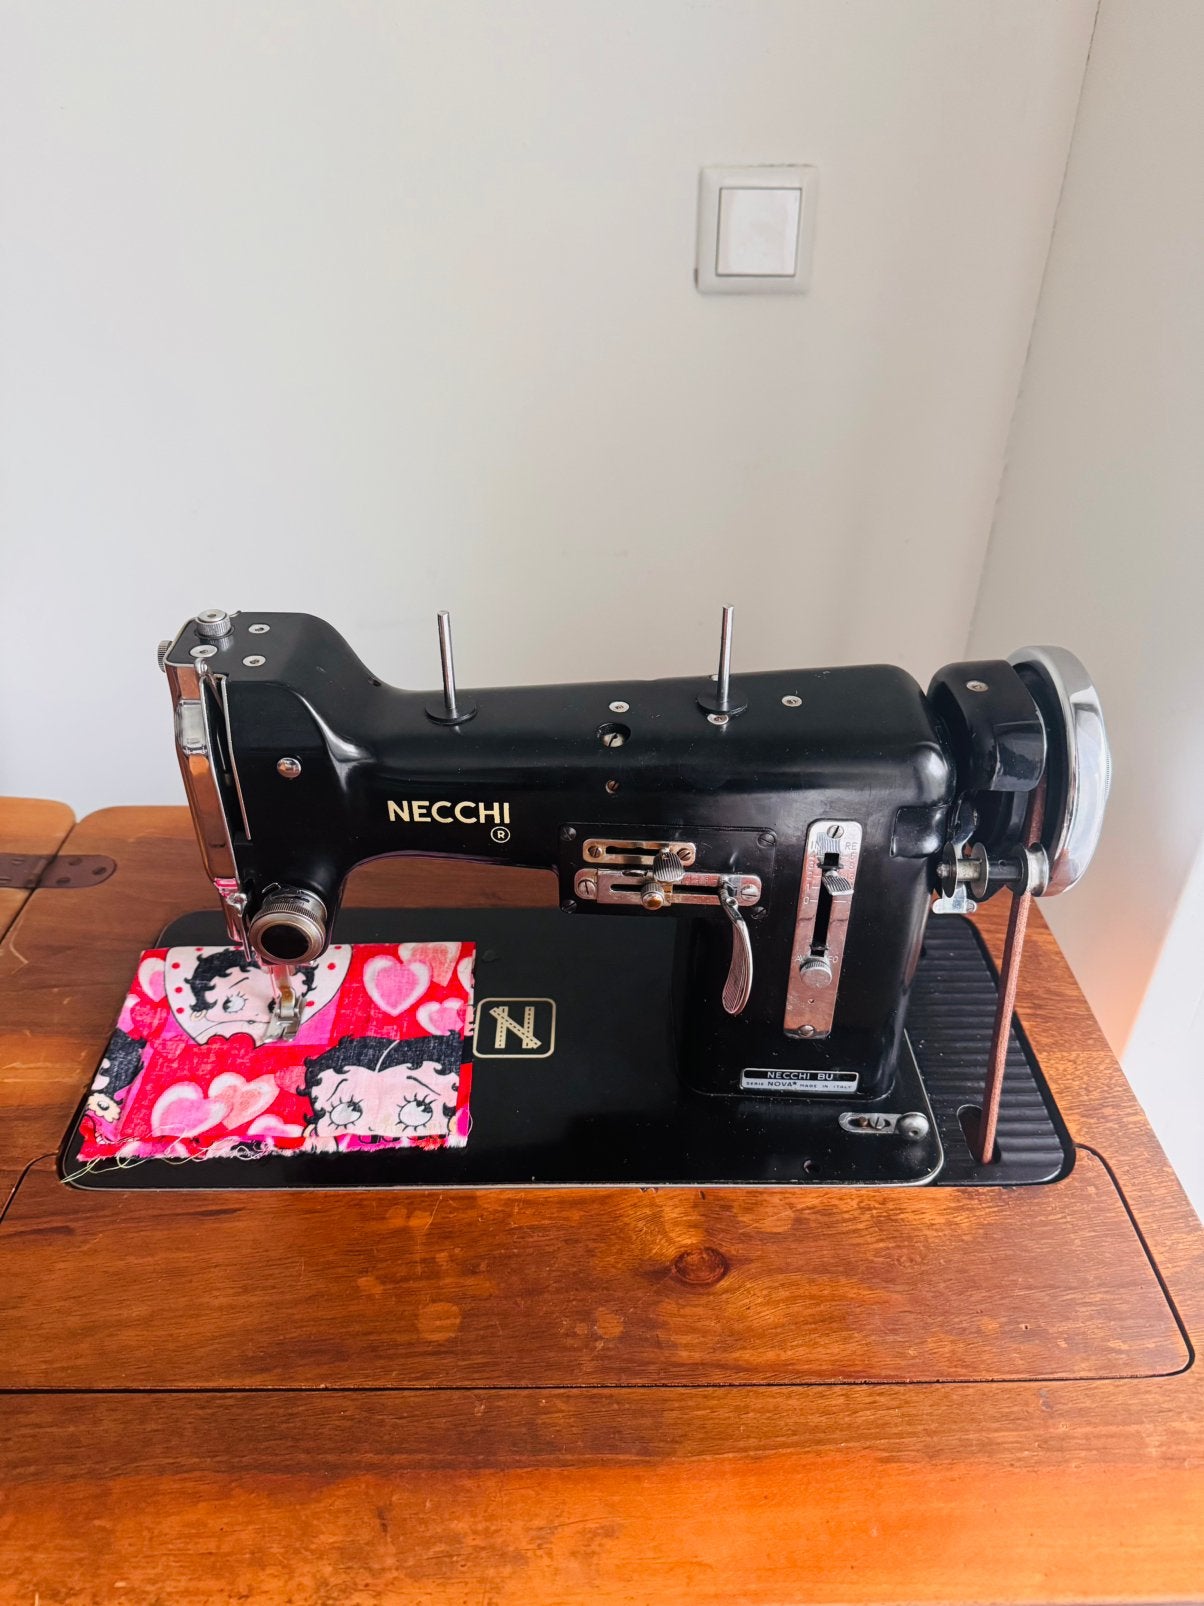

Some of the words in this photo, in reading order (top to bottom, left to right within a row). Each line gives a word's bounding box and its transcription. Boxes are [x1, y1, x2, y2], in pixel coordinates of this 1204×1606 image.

[387, 800, 510, 824] NECCHI
[767, 1071, 811, 1081] NECCHI
[817, 1073, 834, 1081] BU
